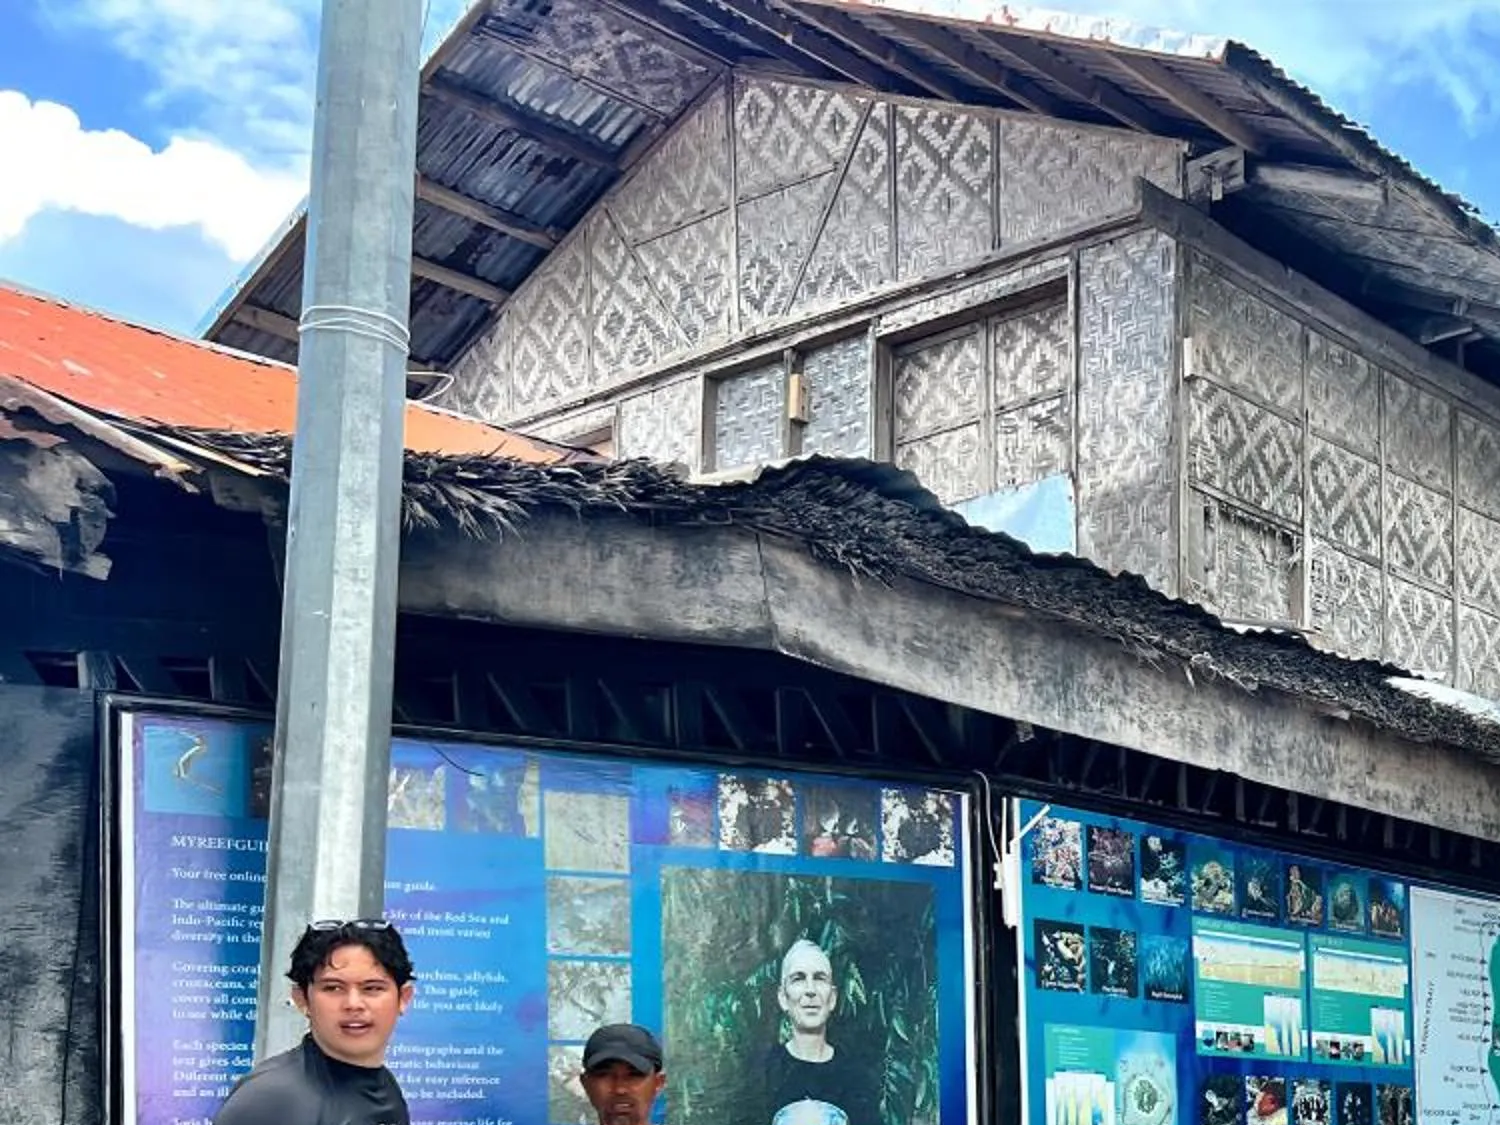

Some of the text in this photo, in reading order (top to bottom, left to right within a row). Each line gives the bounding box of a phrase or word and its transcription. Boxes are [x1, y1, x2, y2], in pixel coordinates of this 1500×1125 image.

[172, 867, 200, 879] Your
[203, 869, 227, 881] free
[173, 899, 195, 910] The
[198, 900, 248, 912] ultimate
[490, 913, 510, 925] and
[172, 914, 246, 928] Indo-Pacific
[227, 931, 239, 943] in
[173, 962, 229, 976] Covering
[424, 984, 447, 995] This
[449, 985, 480, 998] guide
[213, 993, 229, 1005] all
[433, 1002, 453, 1013] you
[211, 1009, 243, 1020] while
[173, 1039, 203, 1050] Each
[206, 1042, 248, 1053] species
[463, 1044, 484, 1055] and
[487, 1044, 504, 1055] the
[199, 1057, 229, 1070] gives
[173, 1070, 227, 1082] Different
[173, 1087, 196, 1097] and
